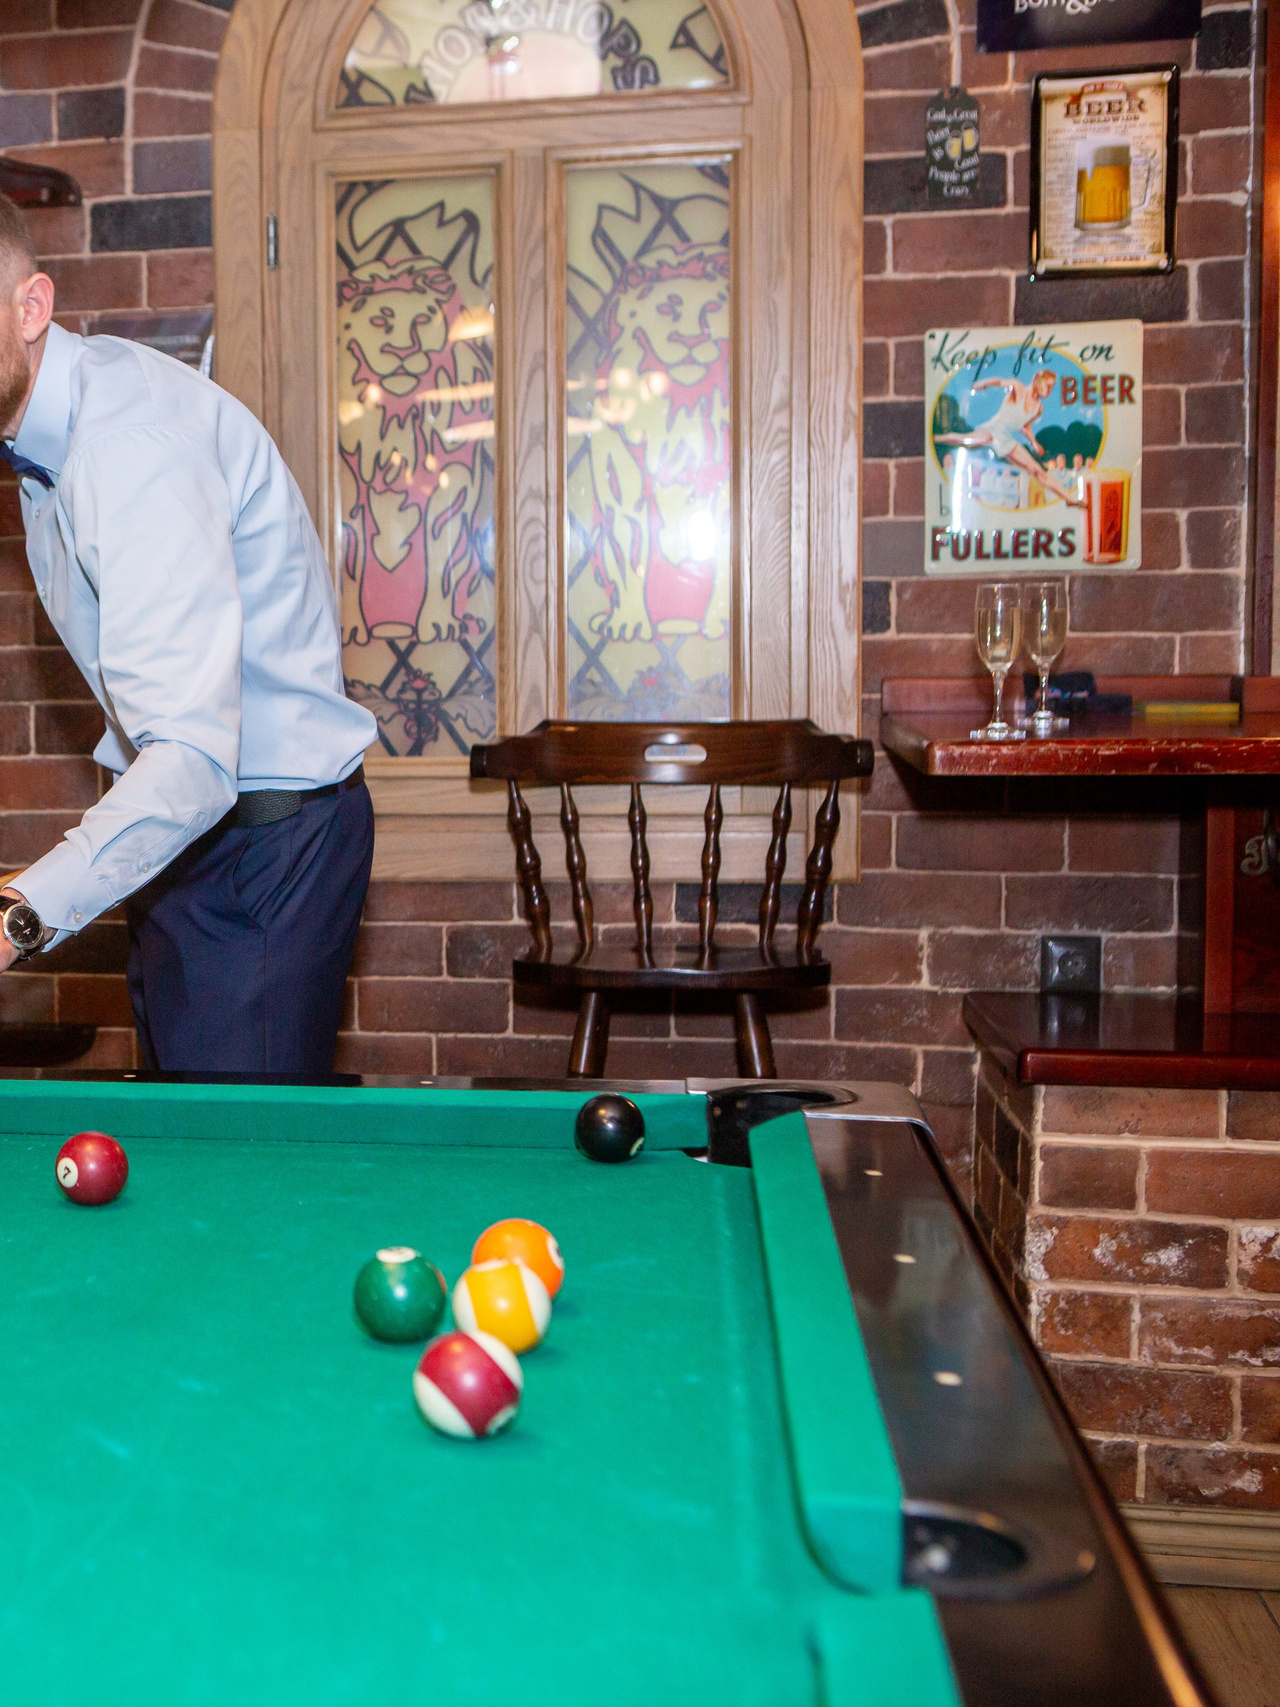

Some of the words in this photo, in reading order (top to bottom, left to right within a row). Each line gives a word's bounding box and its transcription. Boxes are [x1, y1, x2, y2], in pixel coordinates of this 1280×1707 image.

[1064, 99, 1148, 118] BEER
[931, 331, 997, 381] Keep
[1013, 330, 1071, 377] fit
[1079, 342, 1115, 363] on
[1060, 374, 1137, 407] BEER
[930, 526, 1076, 562] FULLERS
[62, 1165, 72, 1180] 7
